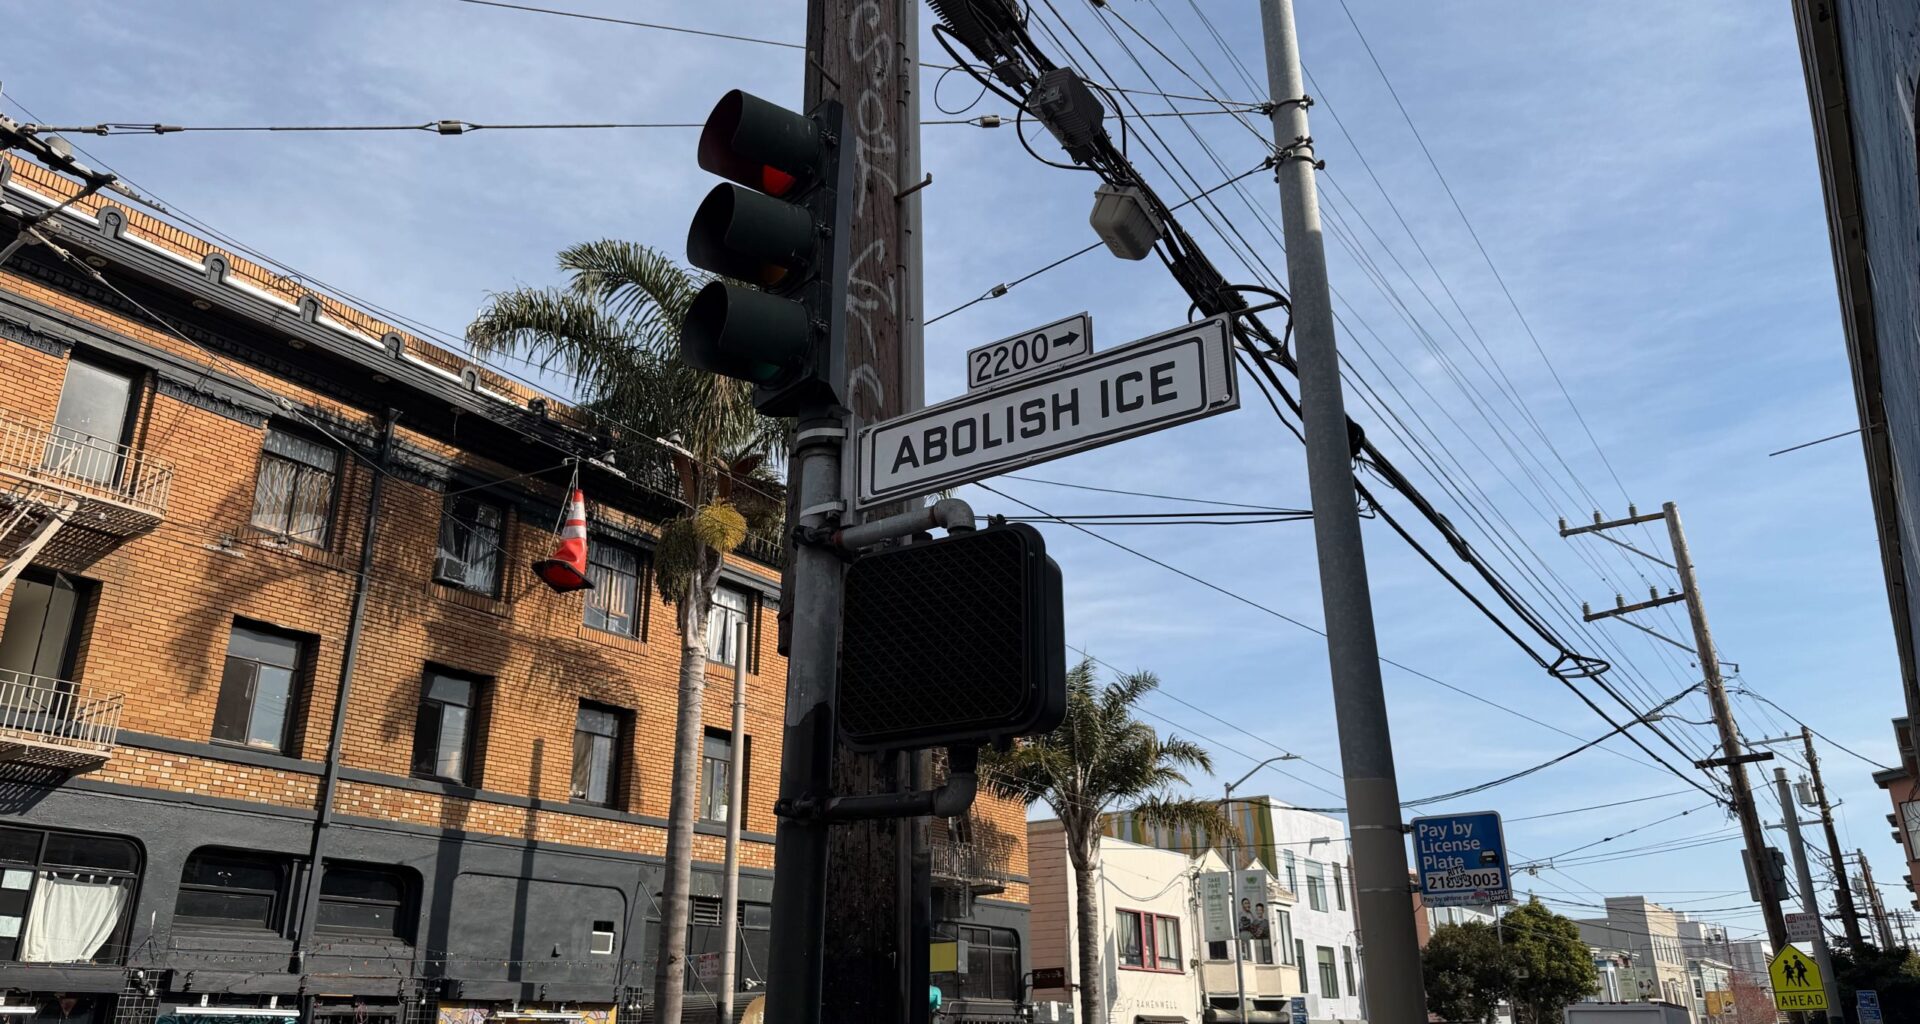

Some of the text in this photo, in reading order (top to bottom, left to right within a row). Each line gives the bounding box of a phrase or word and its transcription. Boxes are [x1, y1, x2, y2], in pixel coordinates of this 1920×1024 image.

[976, 333, 1049, 382] 2200
[891, 360, 1178, 474] ABOLISH ICE
[1419, 821, 1473, 839] Pay by
[1421, 839, 1480, 853] License
[1423, 855, 1464, 870] Plate
[1781, 994, 1823, 1007] AHEAD
